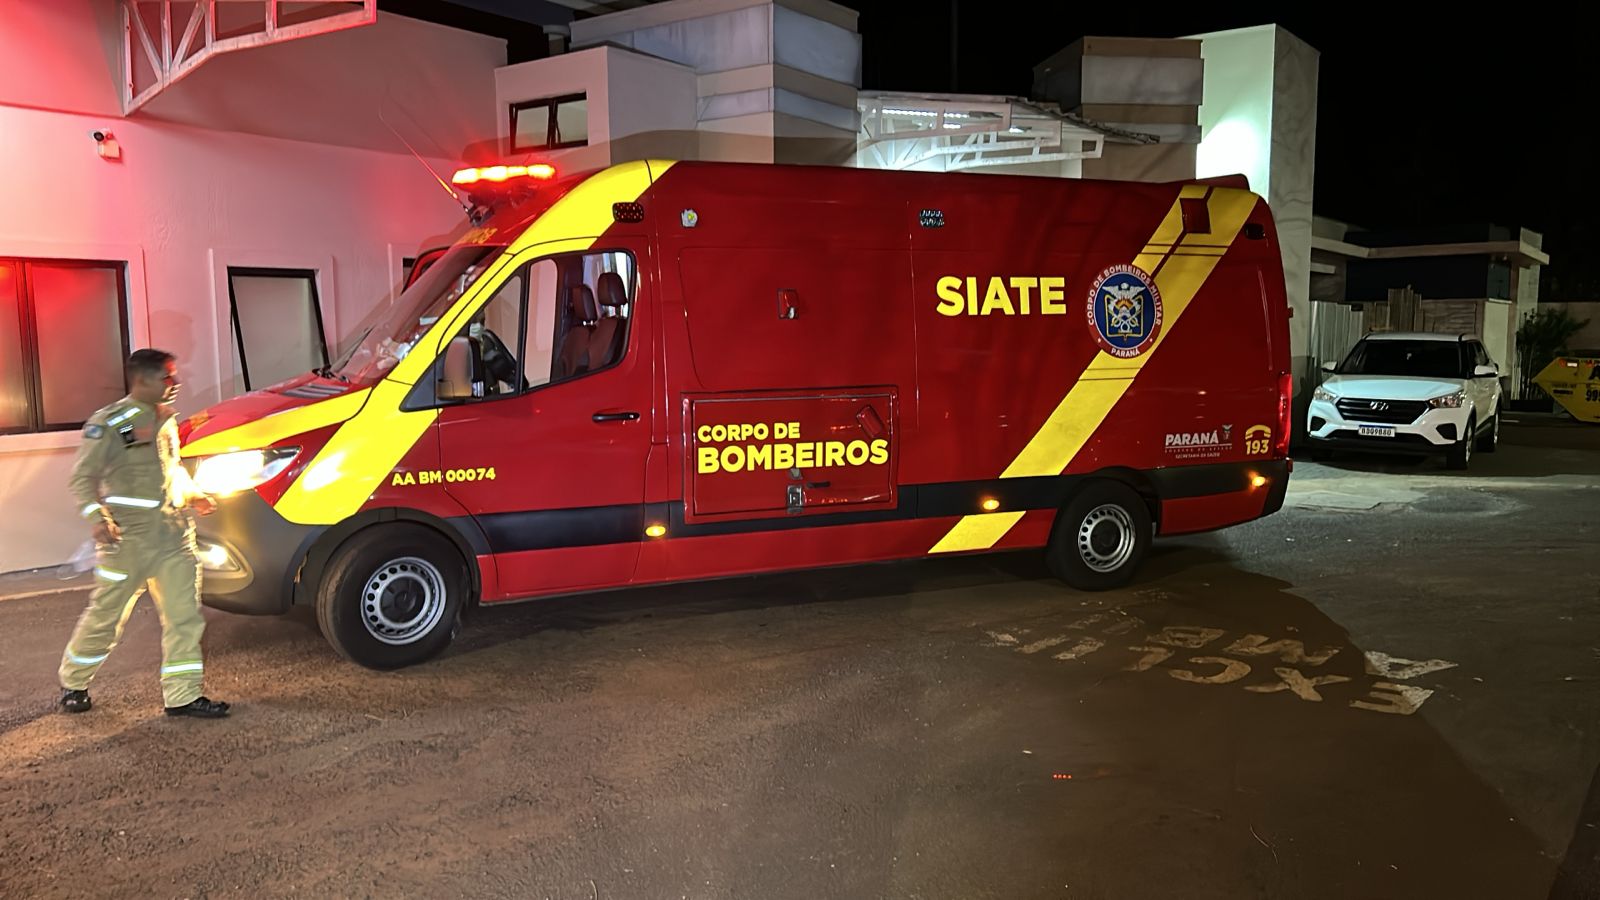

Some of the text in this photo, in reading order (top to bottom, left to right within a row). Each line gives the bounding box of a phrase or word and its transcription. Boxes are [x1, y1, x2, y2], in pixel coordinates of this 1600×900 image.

[936, 276, 1067, 316] SIATE
[1087, 264, 1162, 326] CORPO DE BOMBEIROS MILITAR
[1111, 346, 1140, 358] PARANÁ
[697, 422, 801, 443] CORPO DE
[1165, 430, 1219, 446] PARANÁ
[697, 439, 889, 474] BOMBEIROS
[1245, 439, 1270, 455] 193
[392, 467, 496, 486] AA BM 00074
